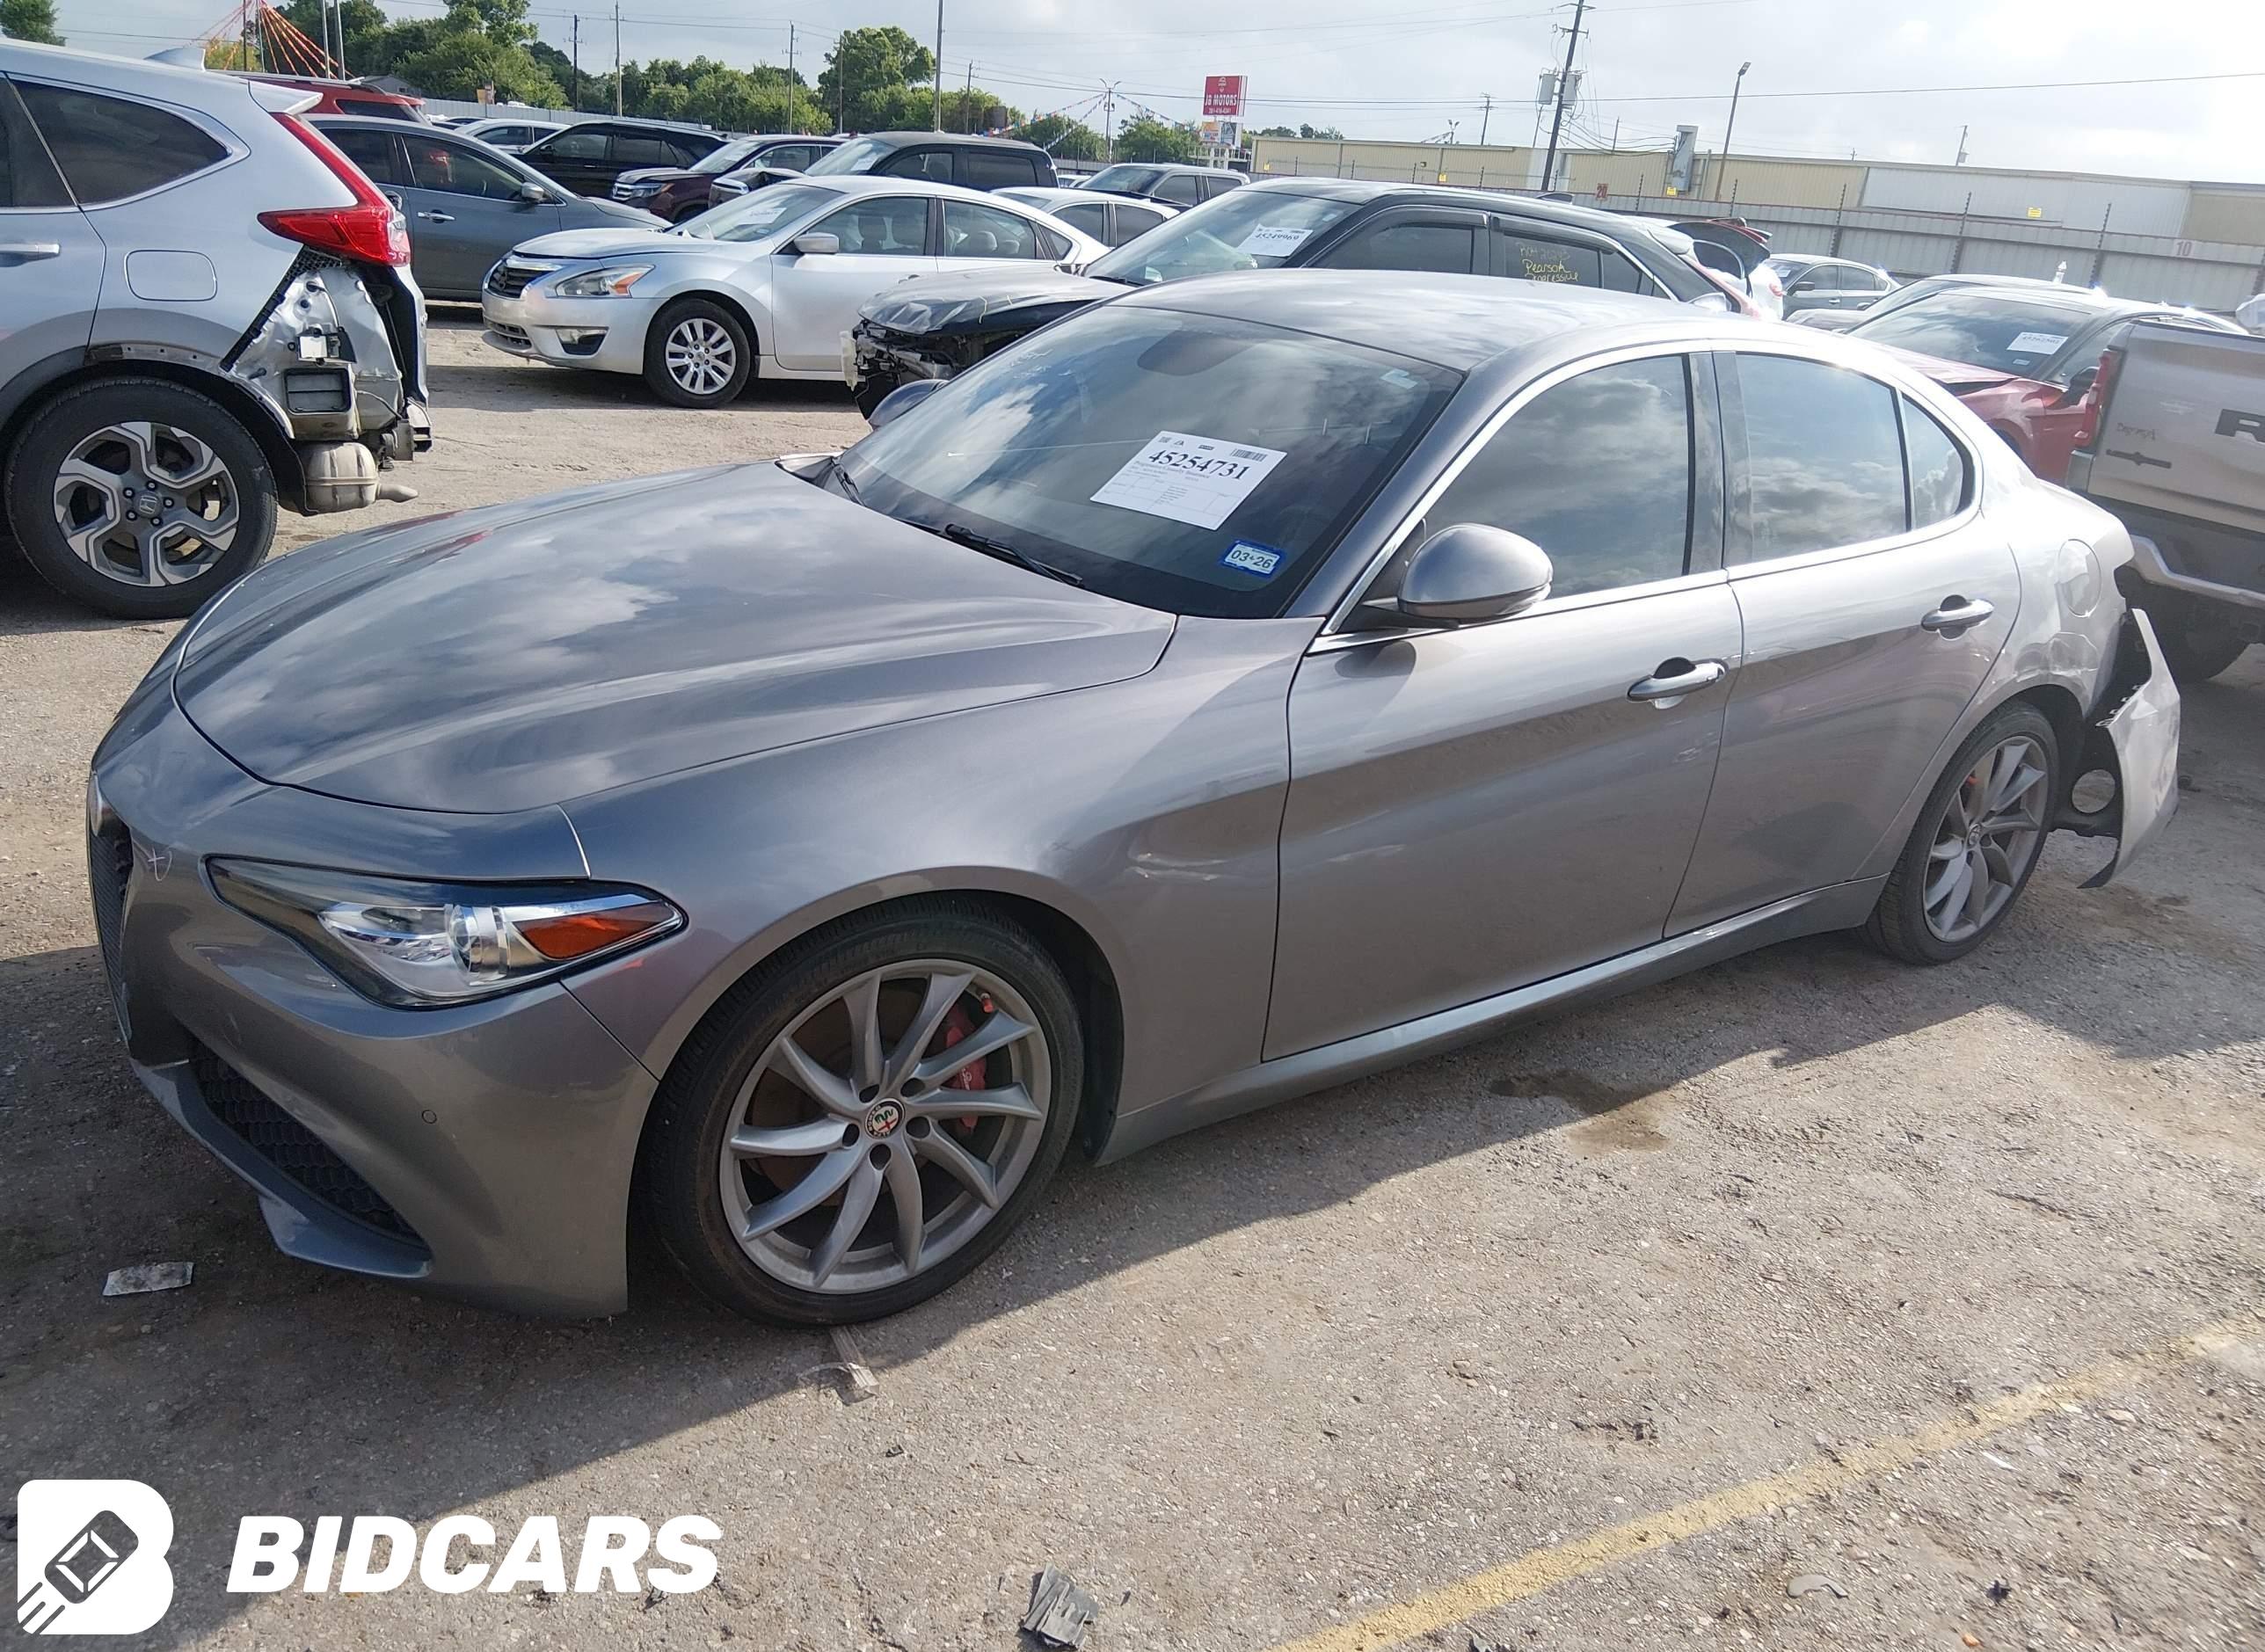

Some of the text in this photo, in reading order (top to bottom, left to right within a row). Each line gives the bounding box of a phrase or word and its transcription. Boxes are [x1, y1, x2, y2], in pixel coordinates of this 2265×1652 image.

[1213, 93, 1238, 106] MOTORS
[1596, 185, 1608, 199] 20
[2176, 241, 2193, 257] 10
[1522, 258, 1571, 274] Pearson
[1147, 449, 1251, 481] 45254731
[1231, 549, 1273, 569] 03 26
